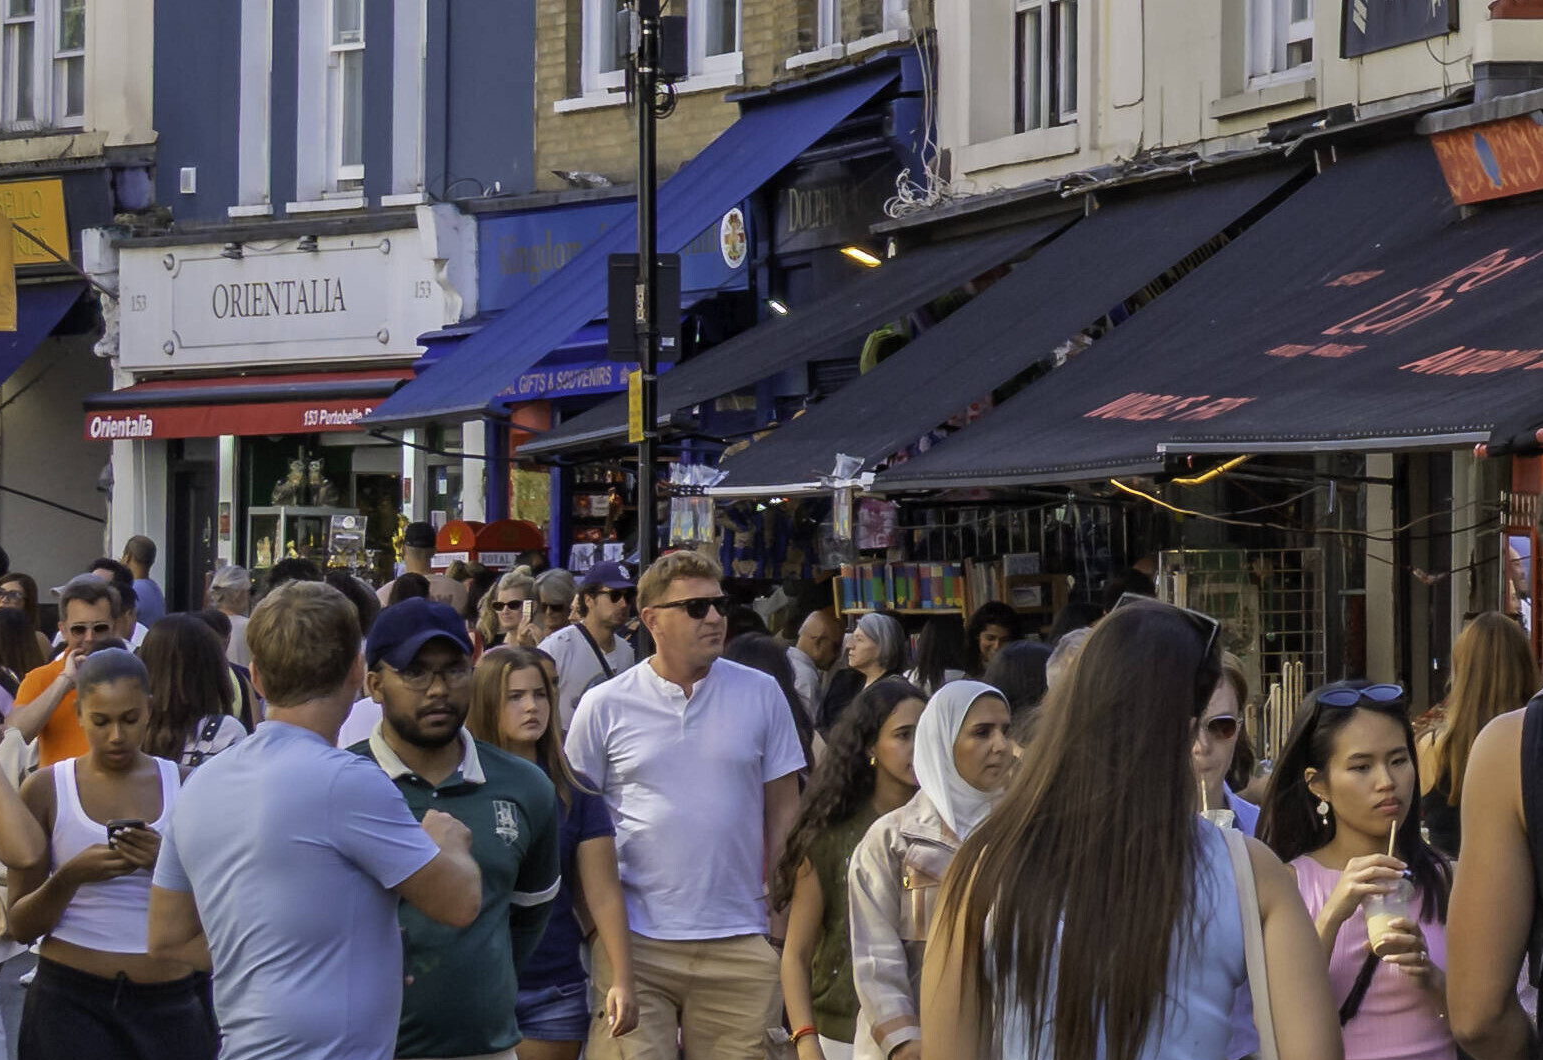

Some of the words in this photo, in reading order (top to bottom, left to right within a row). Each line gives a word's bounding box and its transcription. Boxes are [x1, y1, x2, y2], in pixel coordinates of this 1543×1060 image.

[131, 294, 147, 312] 153
[212, 277, 347, 319] ORIENTALIA
[414, 281, 431, 299] 153
[519, 372, 546, 394] GIFTS
[547, 374, 554, 390] &
[556, 366, 612, 391] SOUVENIRS
[90, 413, 153, 438] Orientalia
[303, 410, 319, 426] 153
